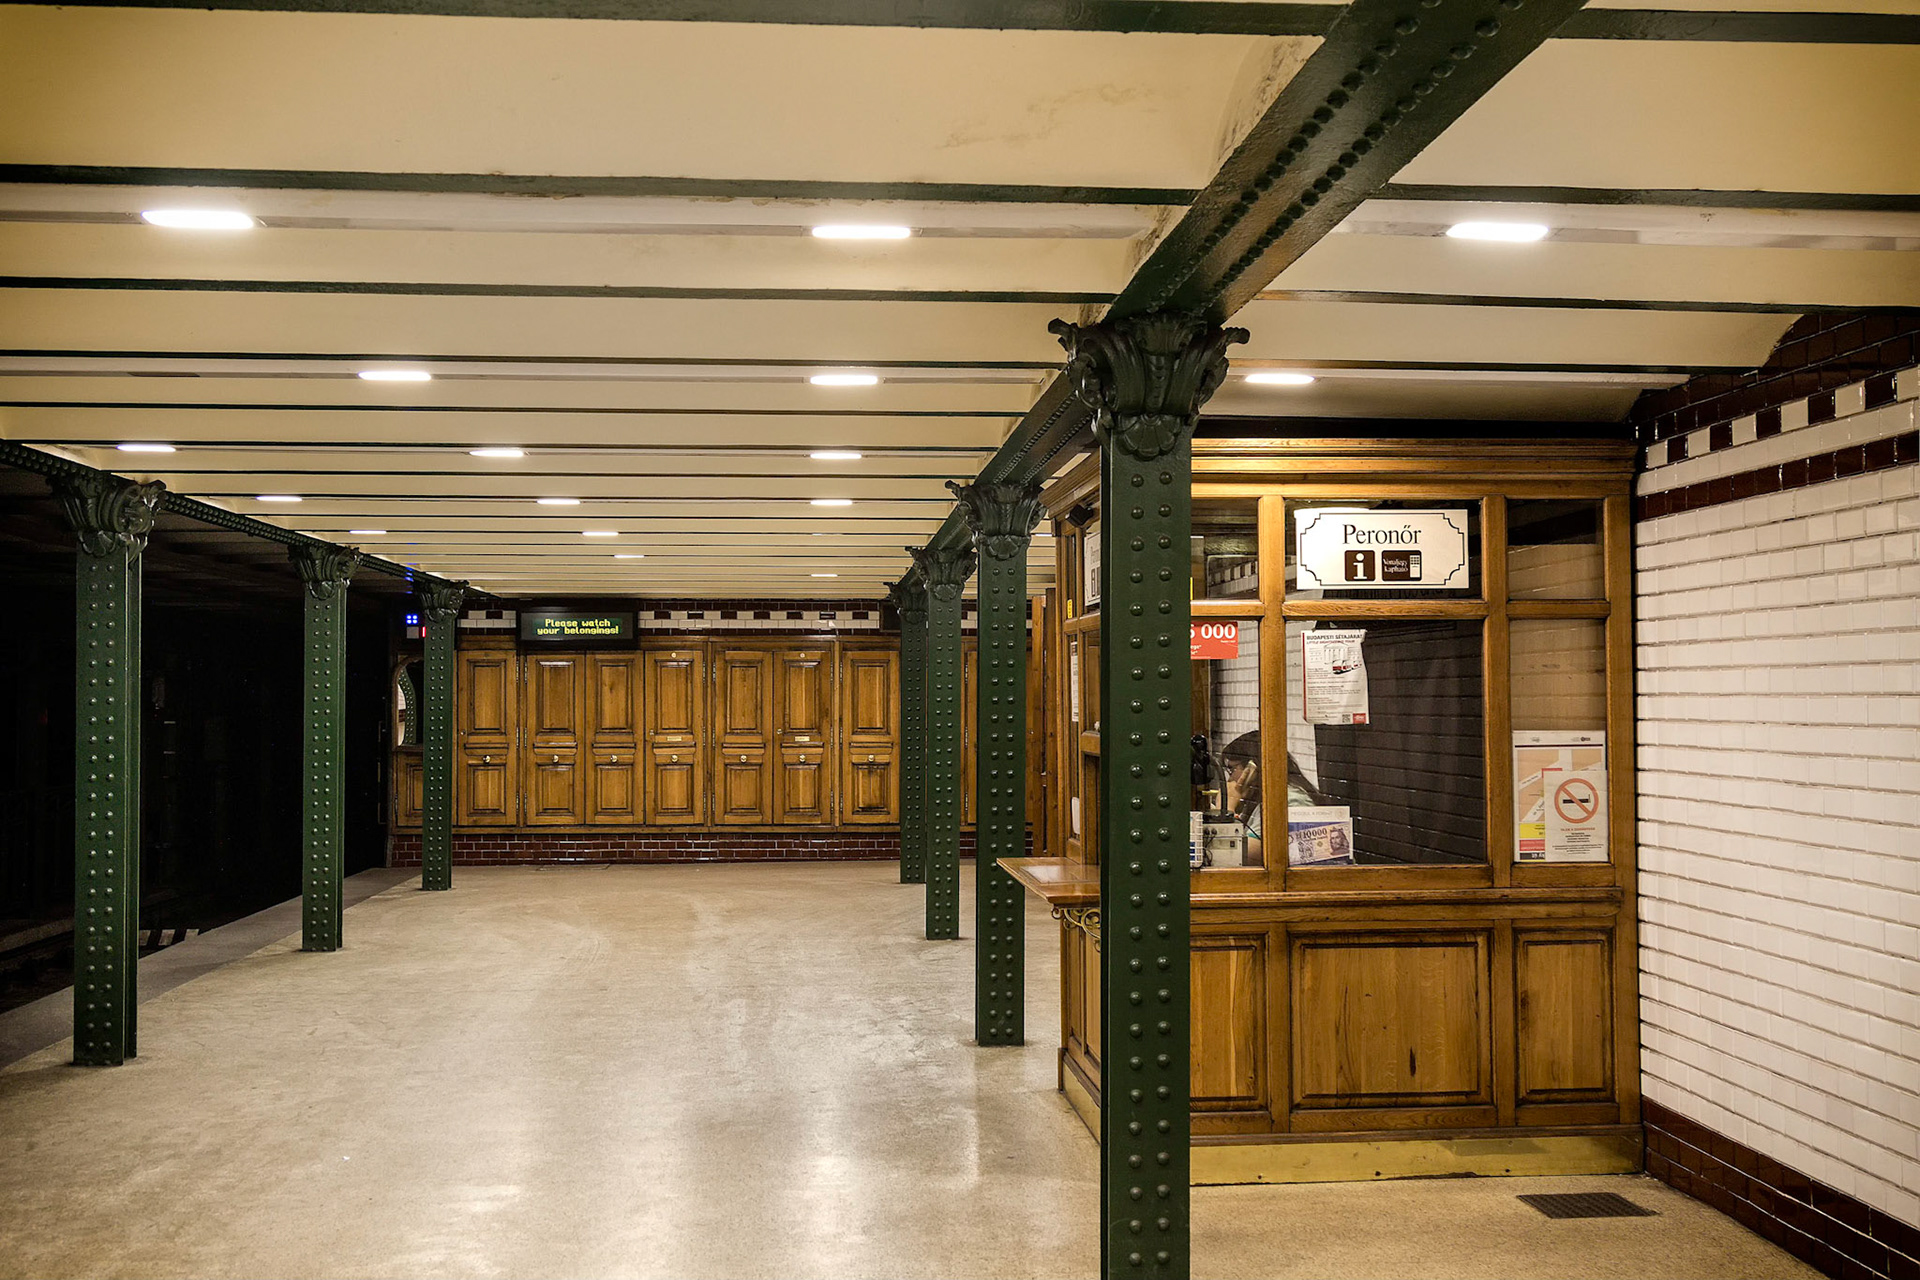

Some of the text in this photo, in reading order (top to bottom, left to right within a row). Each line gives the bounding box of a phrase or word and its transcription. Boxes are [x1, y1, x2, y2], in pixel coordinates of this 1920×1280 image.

[1342, 524, 1422, 544] Peronőr
[545, 619, 611, 627] Please watch
[564, 626, 619, 635] belongings!
[1201, 623, 1236, 639] 000
